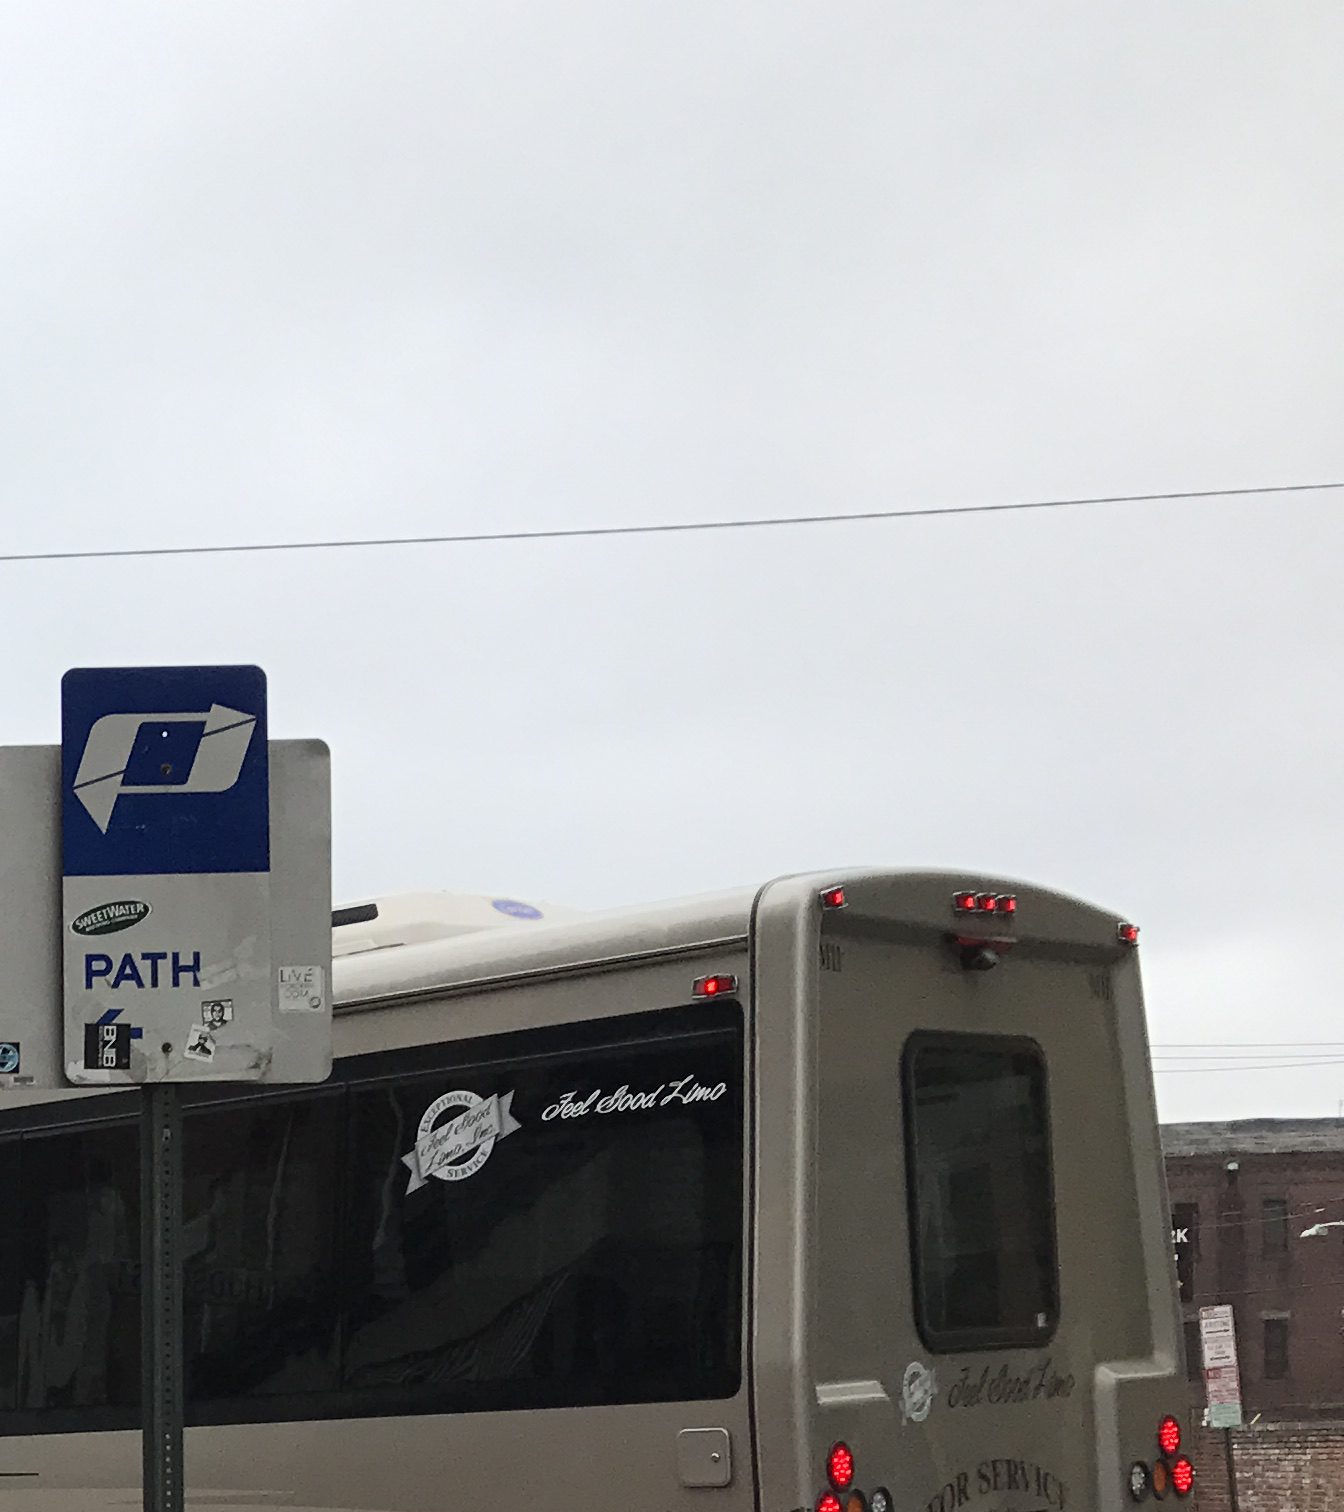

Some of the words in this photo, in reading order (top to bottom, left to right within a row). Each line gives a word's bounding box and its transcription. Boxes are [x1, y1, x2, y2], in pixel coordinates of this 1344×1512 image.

[84, 951, 201, 989] PATH
[541, 1089, 601, 1121] Feel
[594, 1084, 665, 1114] Good
[660, 1074, 727, 1106] Limo
